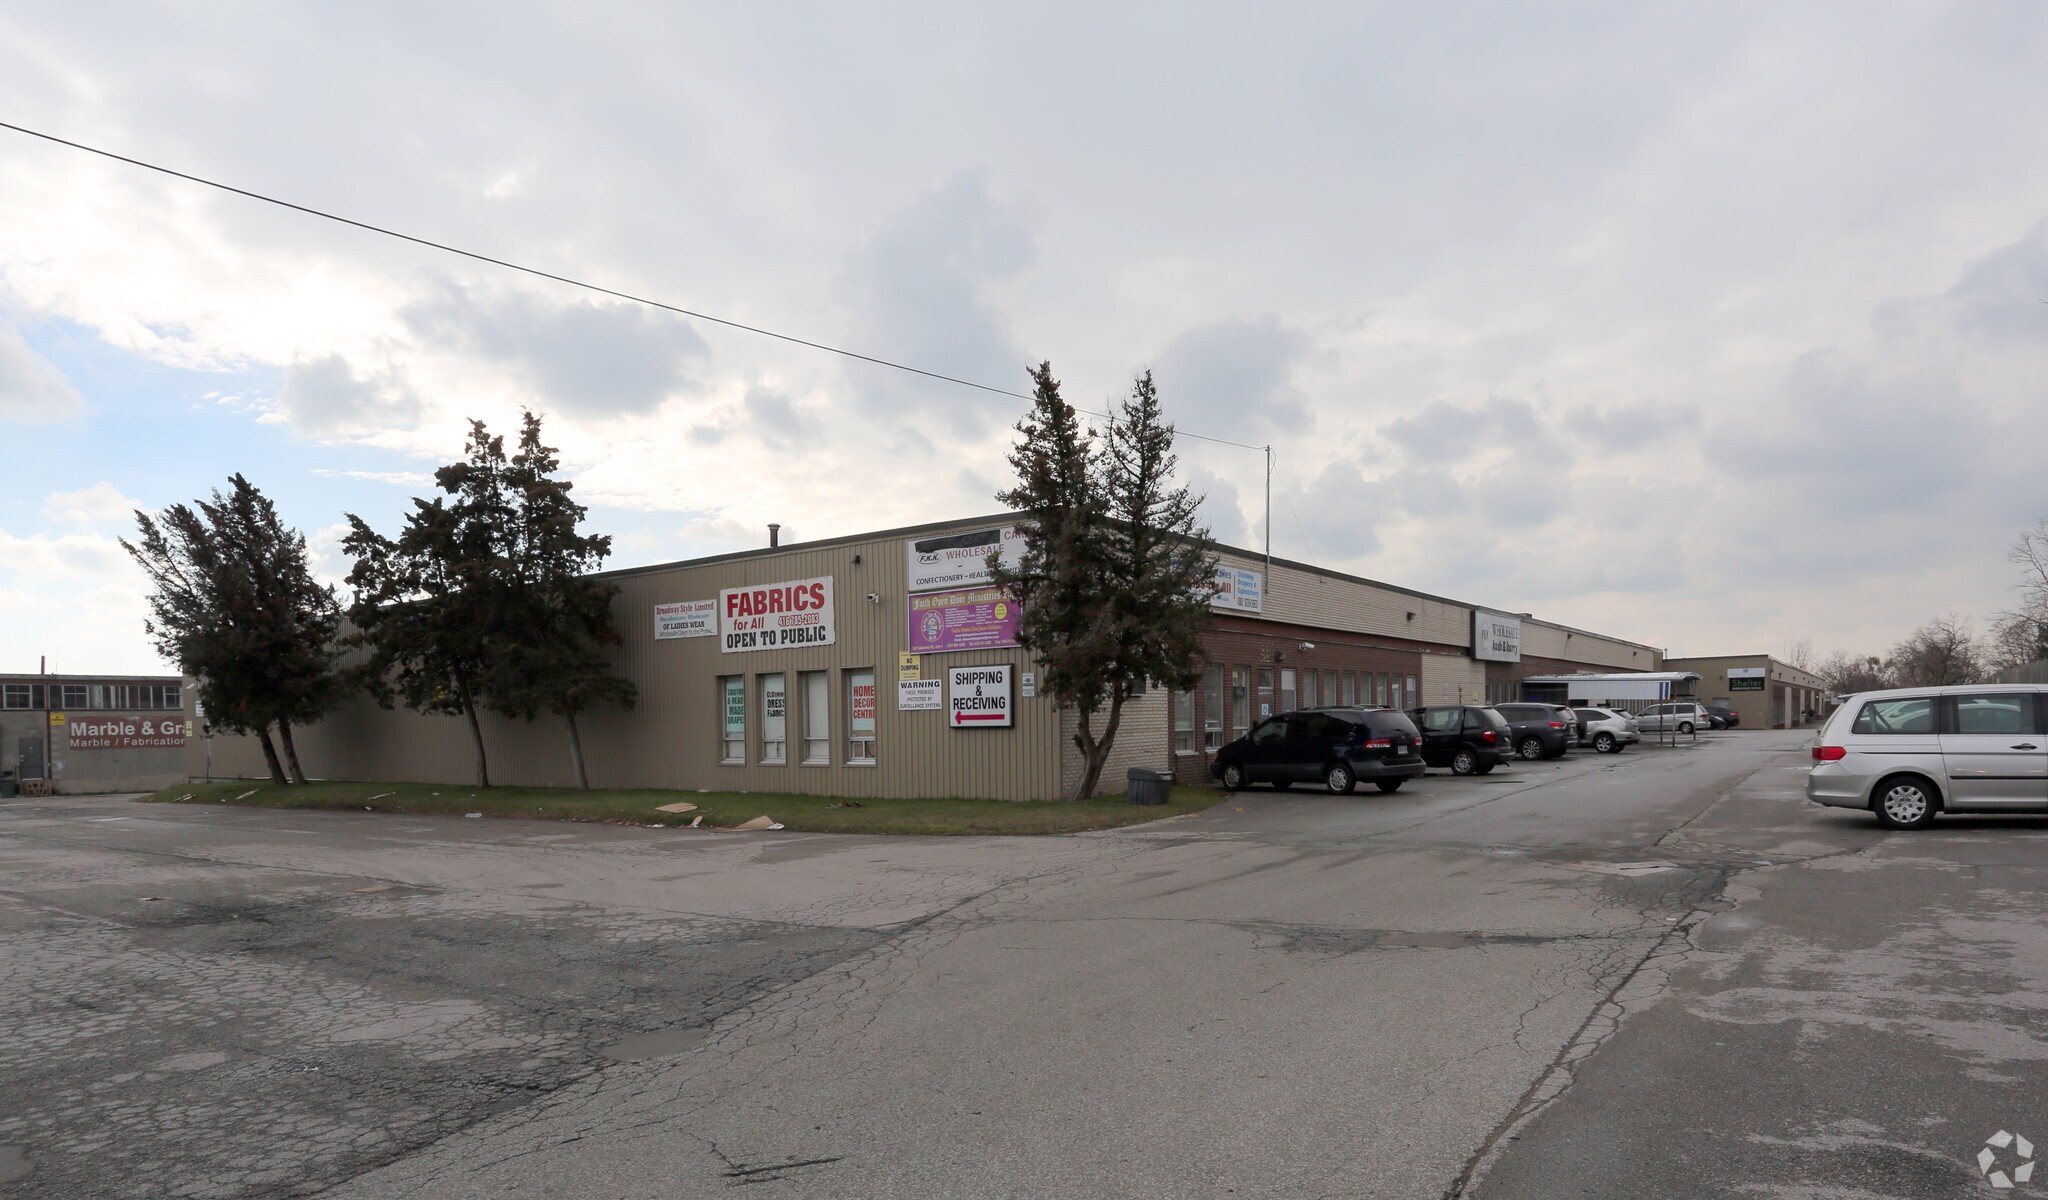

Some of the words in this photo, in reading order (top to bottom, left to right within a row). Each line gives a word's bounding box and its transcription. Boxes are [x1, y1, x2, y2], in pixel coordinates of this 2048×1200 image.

[946, 544, 1004, 560] WHOLESALE
[916, 573, 963, 585] CONFECTIONERY
[727, 583, 825, 618] FABRICS
[914, 598, 930, 610] Faith
[932, 597, 948, 606] Open
[950, 595, 966, 604] Door
[968, 592, 1000, 604] Ministries
[656, 606, 679, 615] Broadway
[680, 604, 692, 614] Style
[695, 602, 714, 611] Limited
[671, 622, 689, 630] LADIES
[734, 619, 748, 631] for
[751, 617, 764, 629] All
[727, 632, 756, 648] OPEN
[761, 630, 776, 645] TO
[781, 626, 826, 644] PUBLIC
[1492, 624, 1518, 639] WHOLESALE
[900, 680, 940, 688] WARNING
[956, 671, 1002, 685] SHIPPING
[854, 686, 874, 696] HOME
[976, 686, 982, 696] &
[854, 698, 874, 708] DECOR
[954, 696, 1006, 710] RECEIVING
[729, 706, 744, 715] MADE
[70, 722, 136, 736] Marble
[142, 722, 154, 735] &
[70, 738, 110, 748] Marble
